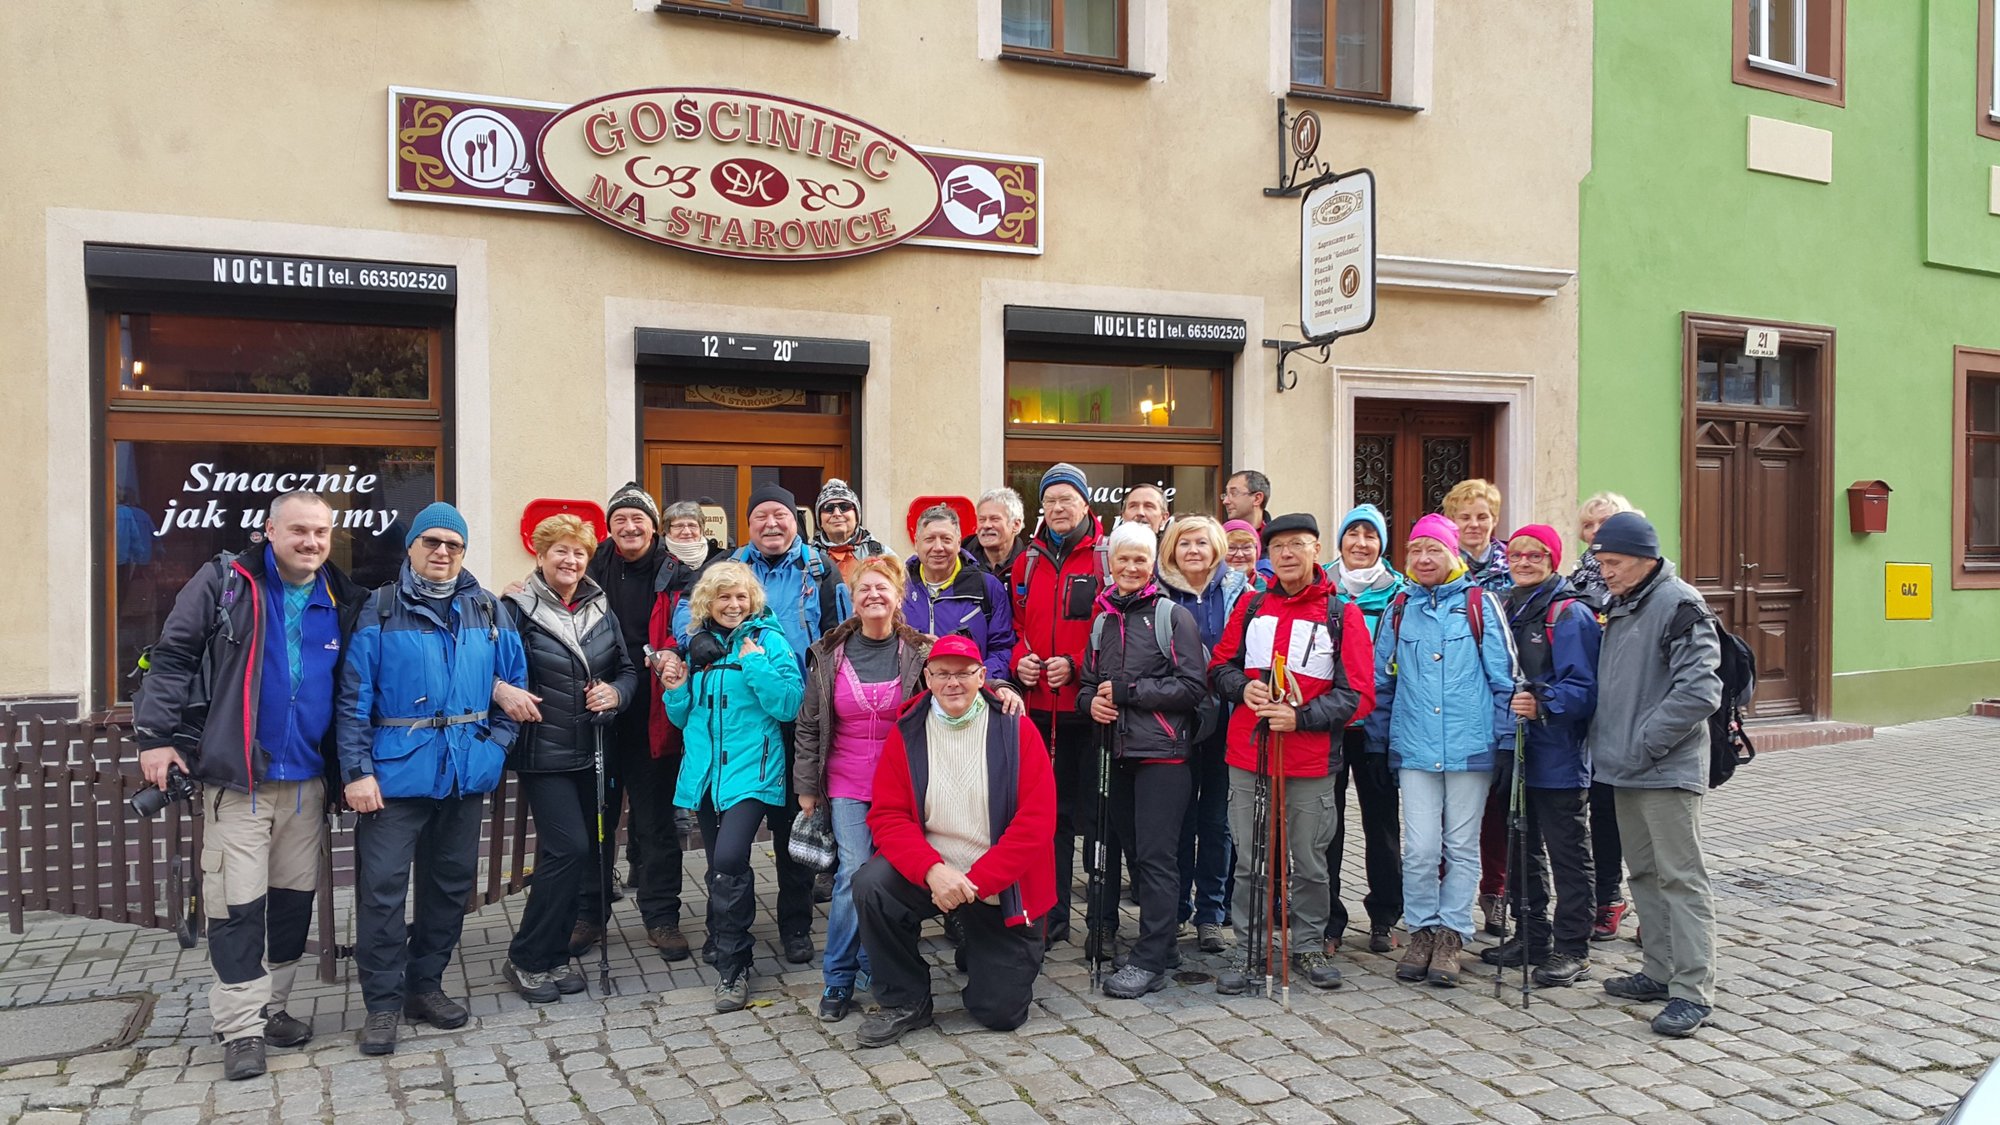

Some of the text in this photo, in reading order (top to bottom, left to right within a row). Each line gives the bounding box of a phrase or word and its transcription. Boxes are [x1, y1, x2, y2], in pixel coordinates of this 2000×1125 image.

[586, 174, 647, 225] NA
[213, 257, 447, 290] NOCLEGI tel. 663502520
[1094, 315, 1245, 340] NOCLEGI tel. 663502520
[1758, 331, 1768, 348] 21
[711, 391, 725, 403] NA
[183, 462, 377, 494] Smacznie
[153, 499, 228, 537] jak
[240, 508, 265, 528] u
[1901, 582, 1918, 597] GAZ
